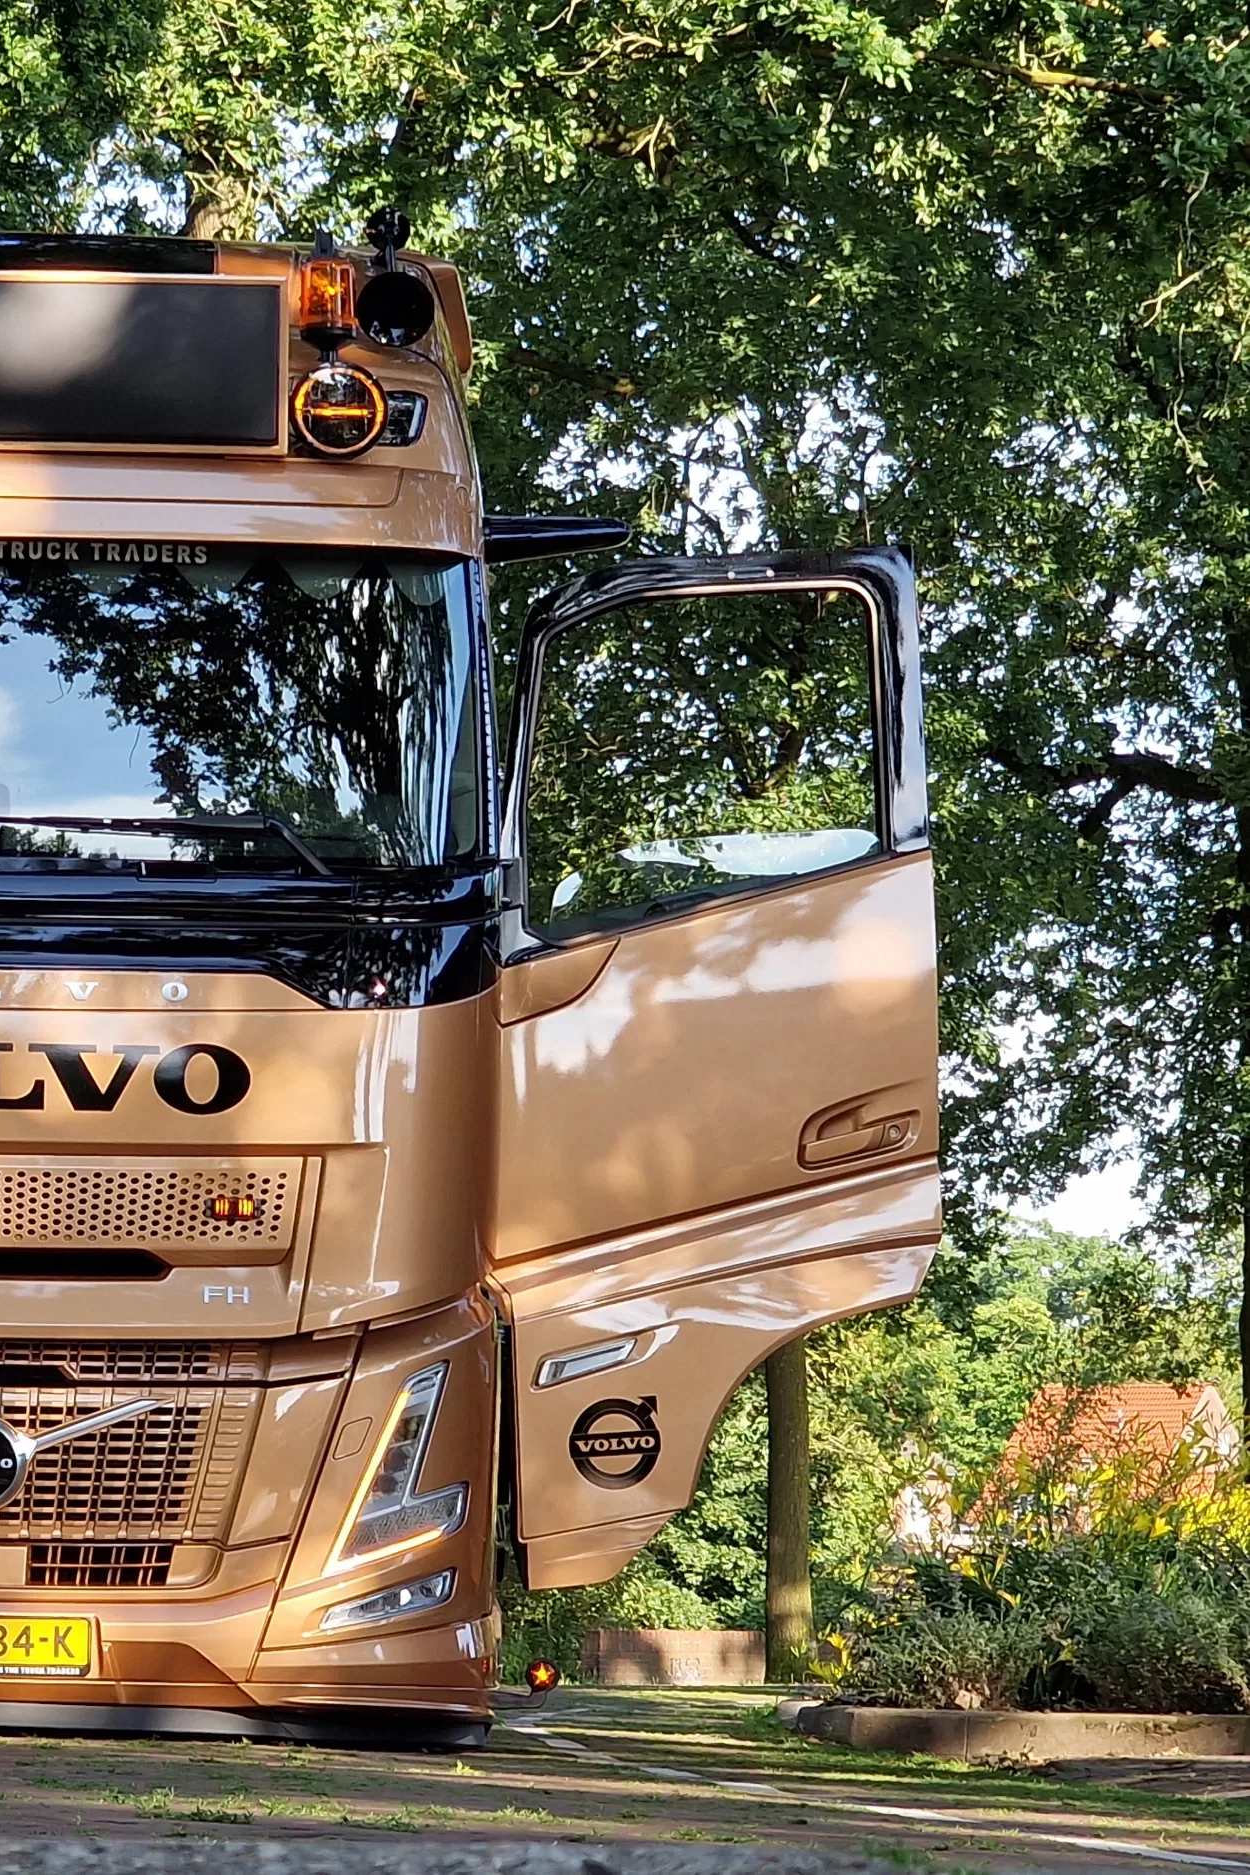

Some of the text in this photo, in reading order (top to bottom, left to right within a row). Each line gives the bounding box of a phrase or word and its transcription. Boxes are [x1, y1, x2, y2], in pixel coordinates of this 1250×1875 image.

[90, 542, 208, 564] TRADERS
[203, 1286, 250, 1304] FH
[574, 1435, 656, 1453] VOLVO
